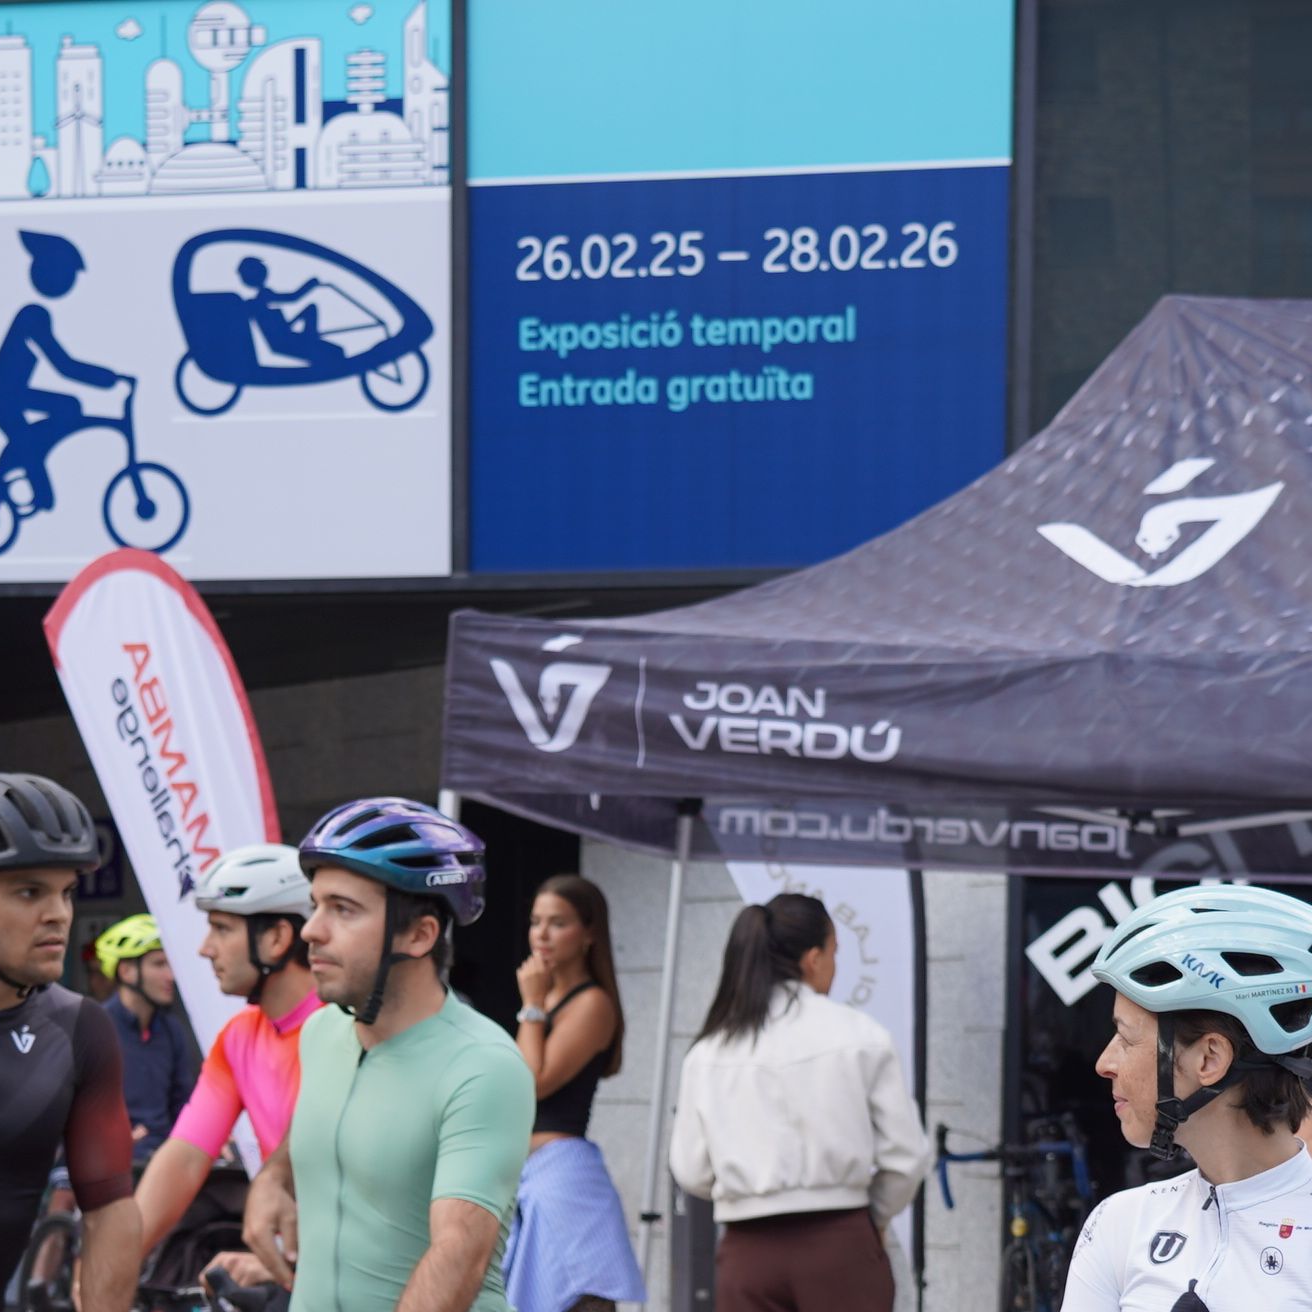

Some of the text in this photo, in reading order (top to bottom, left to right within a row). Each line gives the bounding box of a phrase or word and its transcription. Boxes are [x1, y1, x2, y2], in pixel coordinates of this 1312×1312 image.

[515, 231, 705, 281] 26.02.25
[762, 221, 959, 274] 28.02.26
[519, 306, 857, 358] Exposició temporal
[519, 366, 814, 412] Entrada gratuïta
[683, 681, 826, 719] JOAN
[669, 713, 902, 763] VERDÚ
[1181, 953, 1226, 989] KASK
